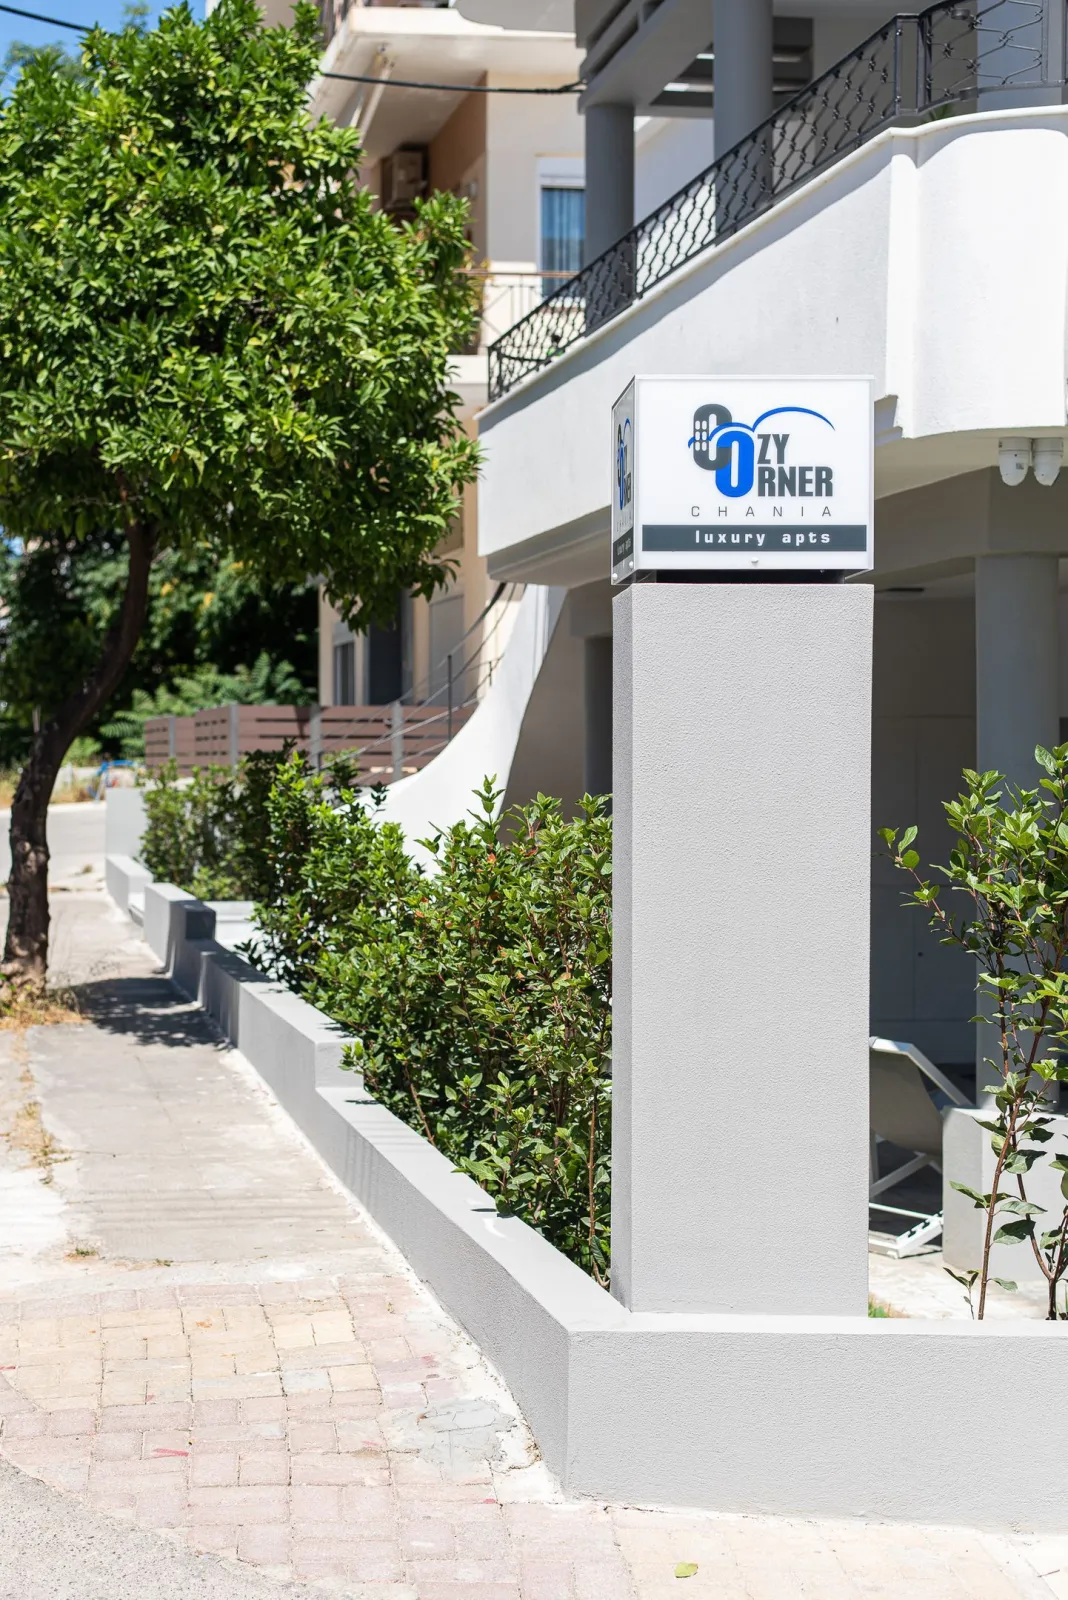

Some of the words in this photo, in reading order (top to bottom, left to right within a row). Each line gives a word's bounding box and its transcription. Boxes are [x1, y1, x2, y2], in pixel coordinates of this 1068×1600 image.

[691, 505, 832, 518] CHANIA
[695, 529, 766, 547] luxury
[781, 531, 831, 547] apts
